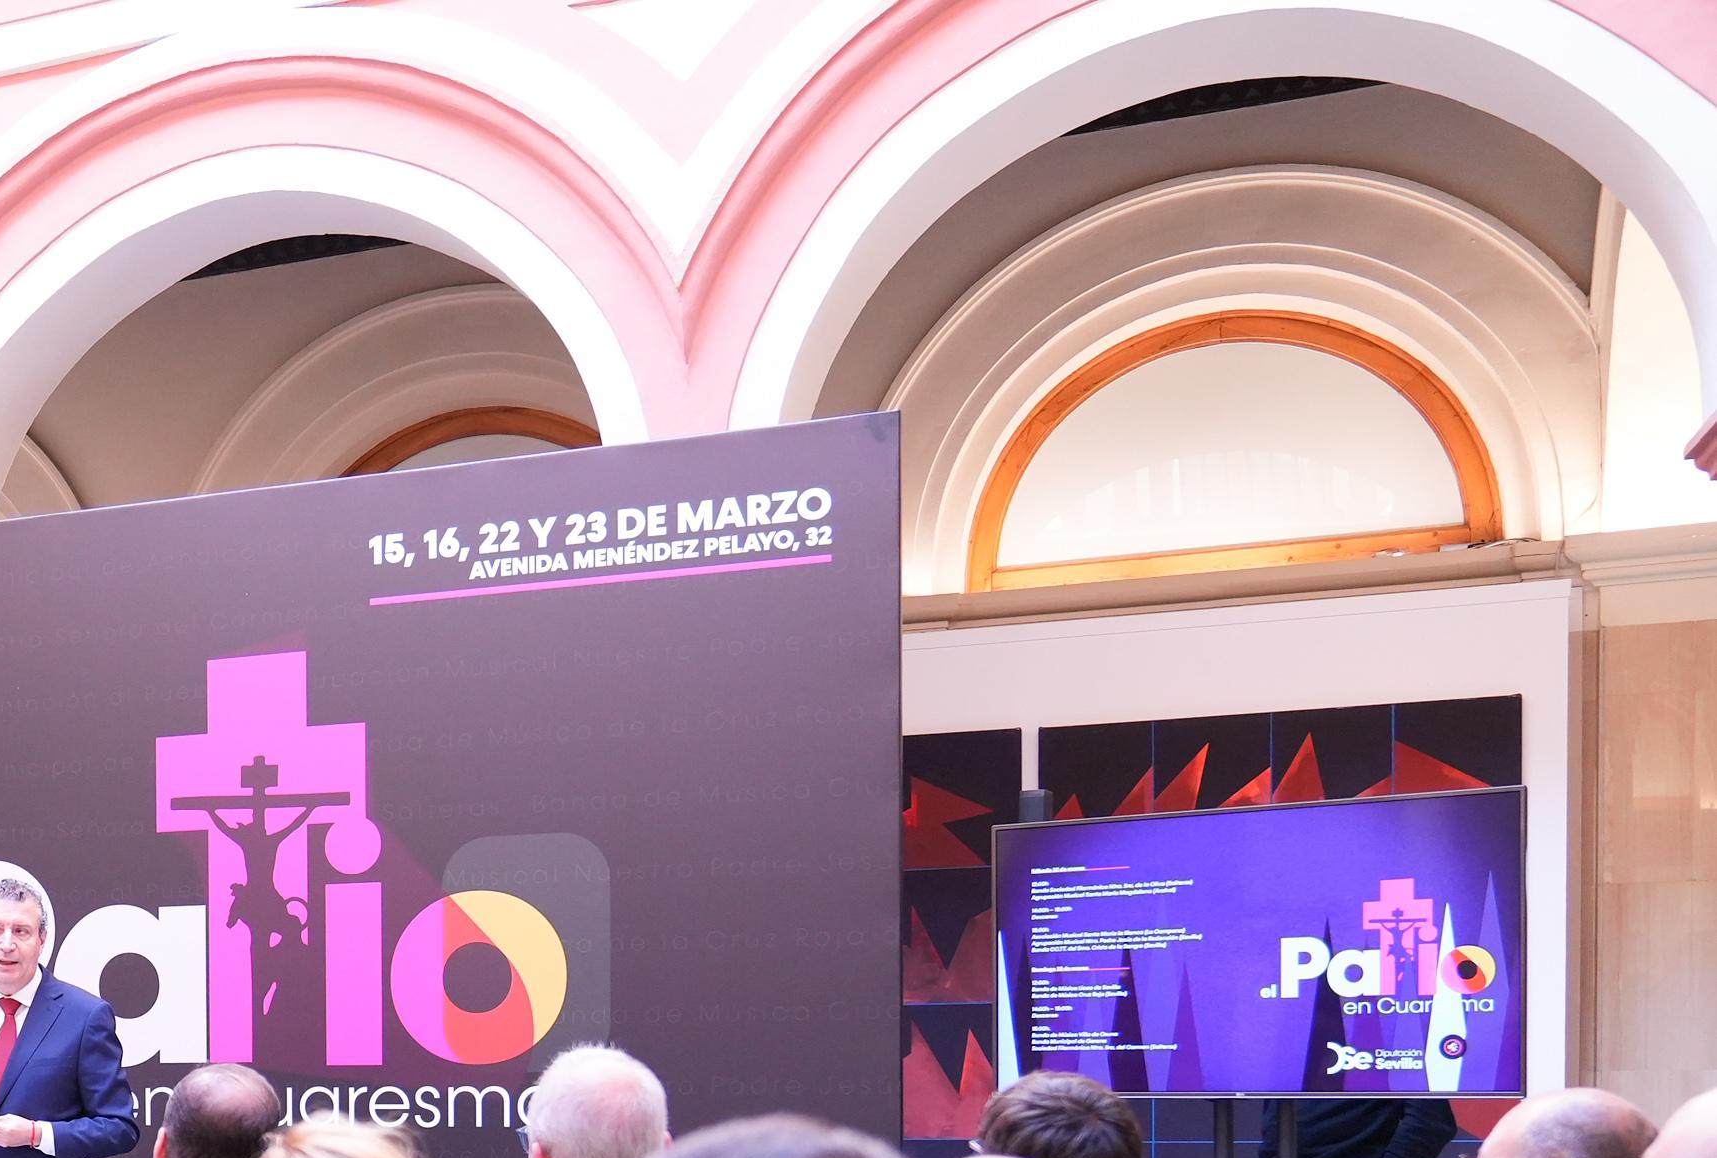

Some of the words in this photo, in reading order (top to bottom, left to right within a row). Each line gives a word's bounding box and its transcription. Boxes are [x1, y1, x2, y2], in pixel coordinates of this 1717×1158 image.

[368, 532, 414, 568] 15,
[423, 527, 470, 562] 16,
[478, 520, 520, 555] 22
[528, 516, 557, 548] Y
[565, 511, 607, 545] 23
[617, 504, 667, 540] DE
[676, 487, 832, 533] MARZO
[469, 551, 569, 580] AVENIDA
[573, 540, 700, 570] MENÉNDEZ
[704, 529, 801, 559] PELAYO,
[805, 525, 833, 548] 32
[1259, 984, 1277, 998] el
[1343, 1000, 1371, 1014] en
[1375, 1048, 1423, 1059] Diputación
[1375, 1057, 1423, 1070] Sevilla
